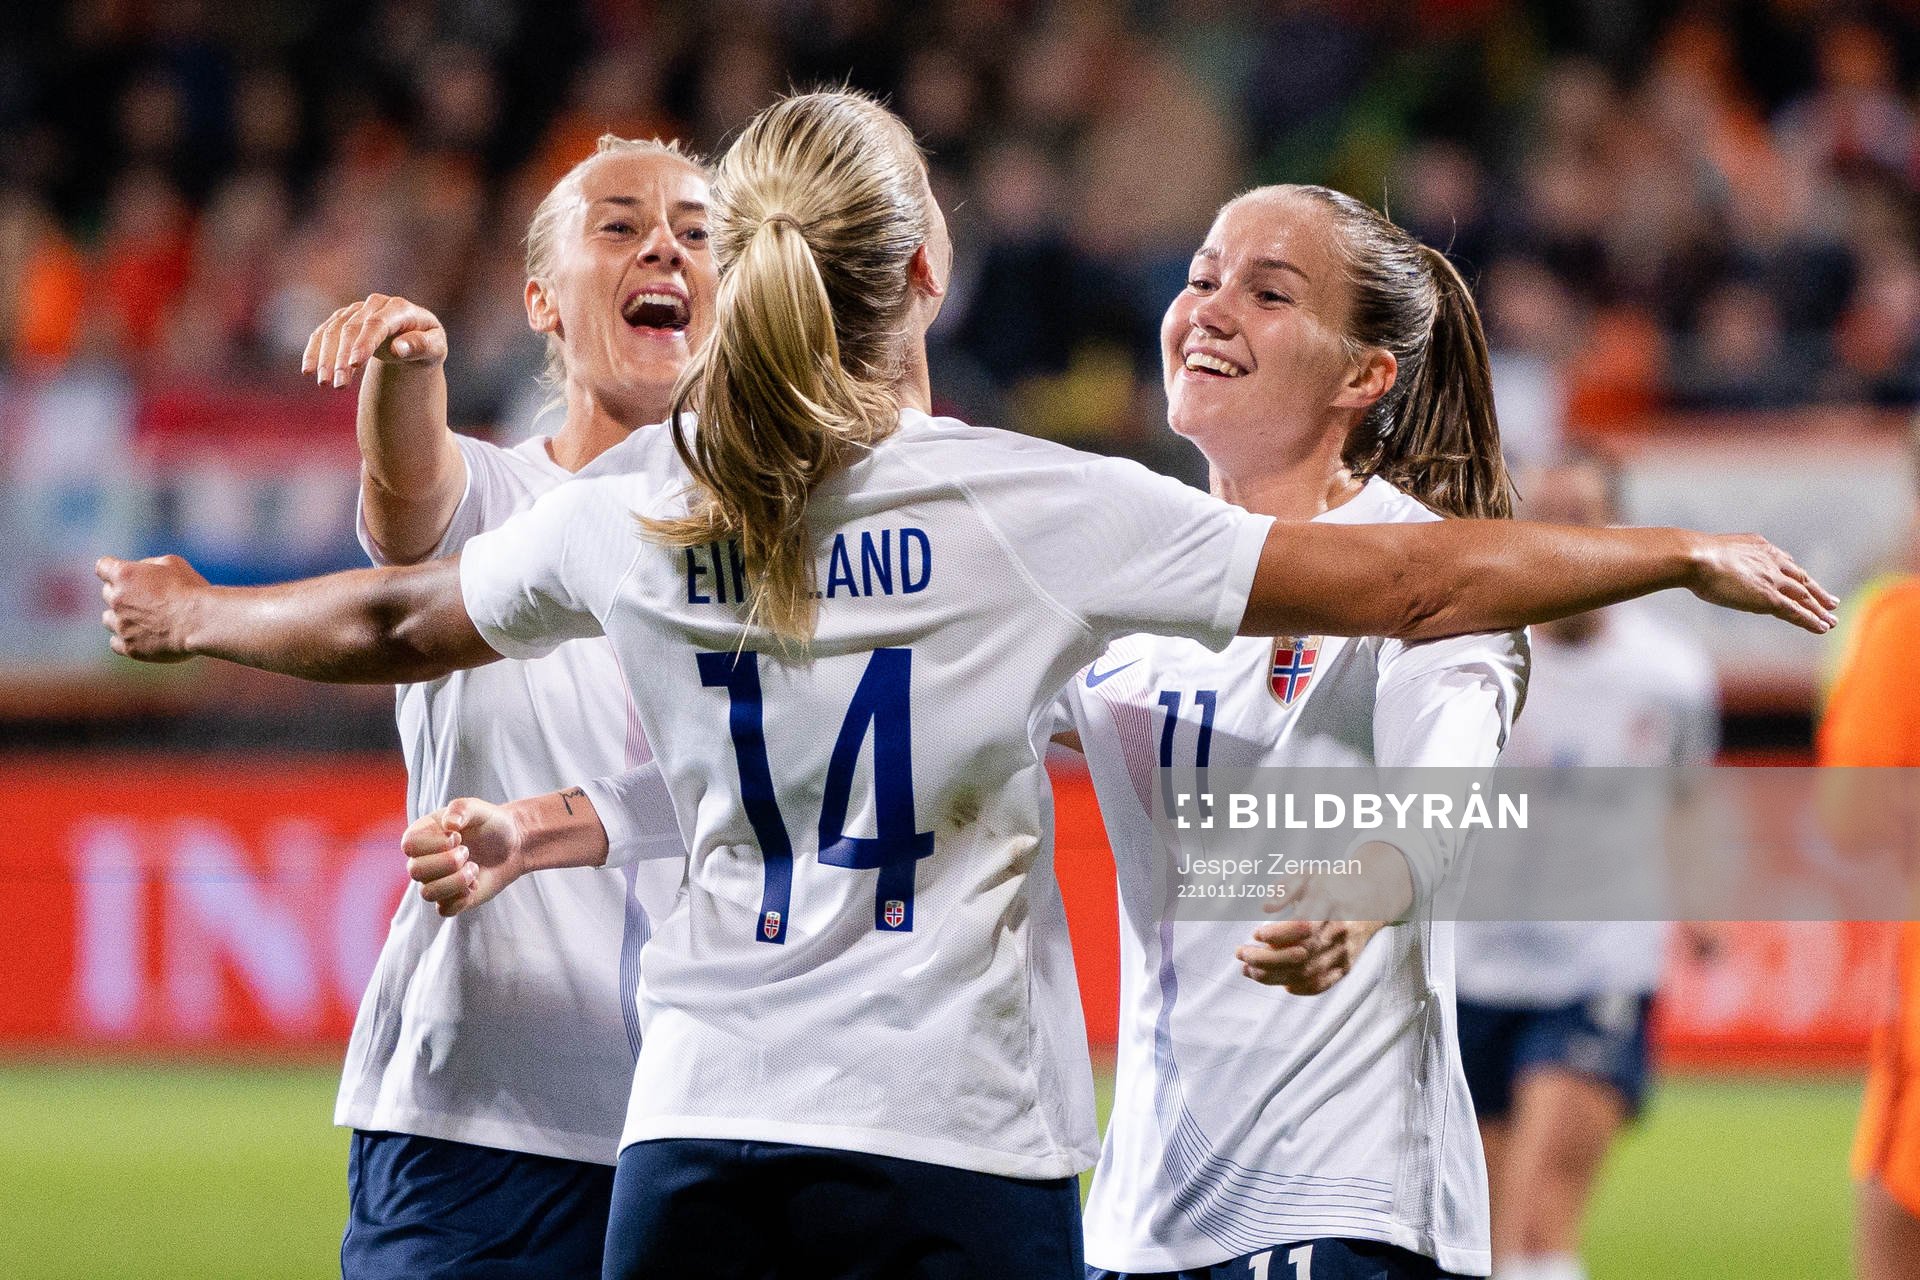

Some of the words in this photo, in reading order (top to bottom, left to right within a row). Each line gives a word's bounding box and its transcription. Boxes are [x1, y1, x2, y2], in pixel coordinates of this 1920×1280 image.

[686, 528, 932, 605] EIKAND
[696, 648, 935, 944] 14
[1158, 690, 1217, 820] 11
